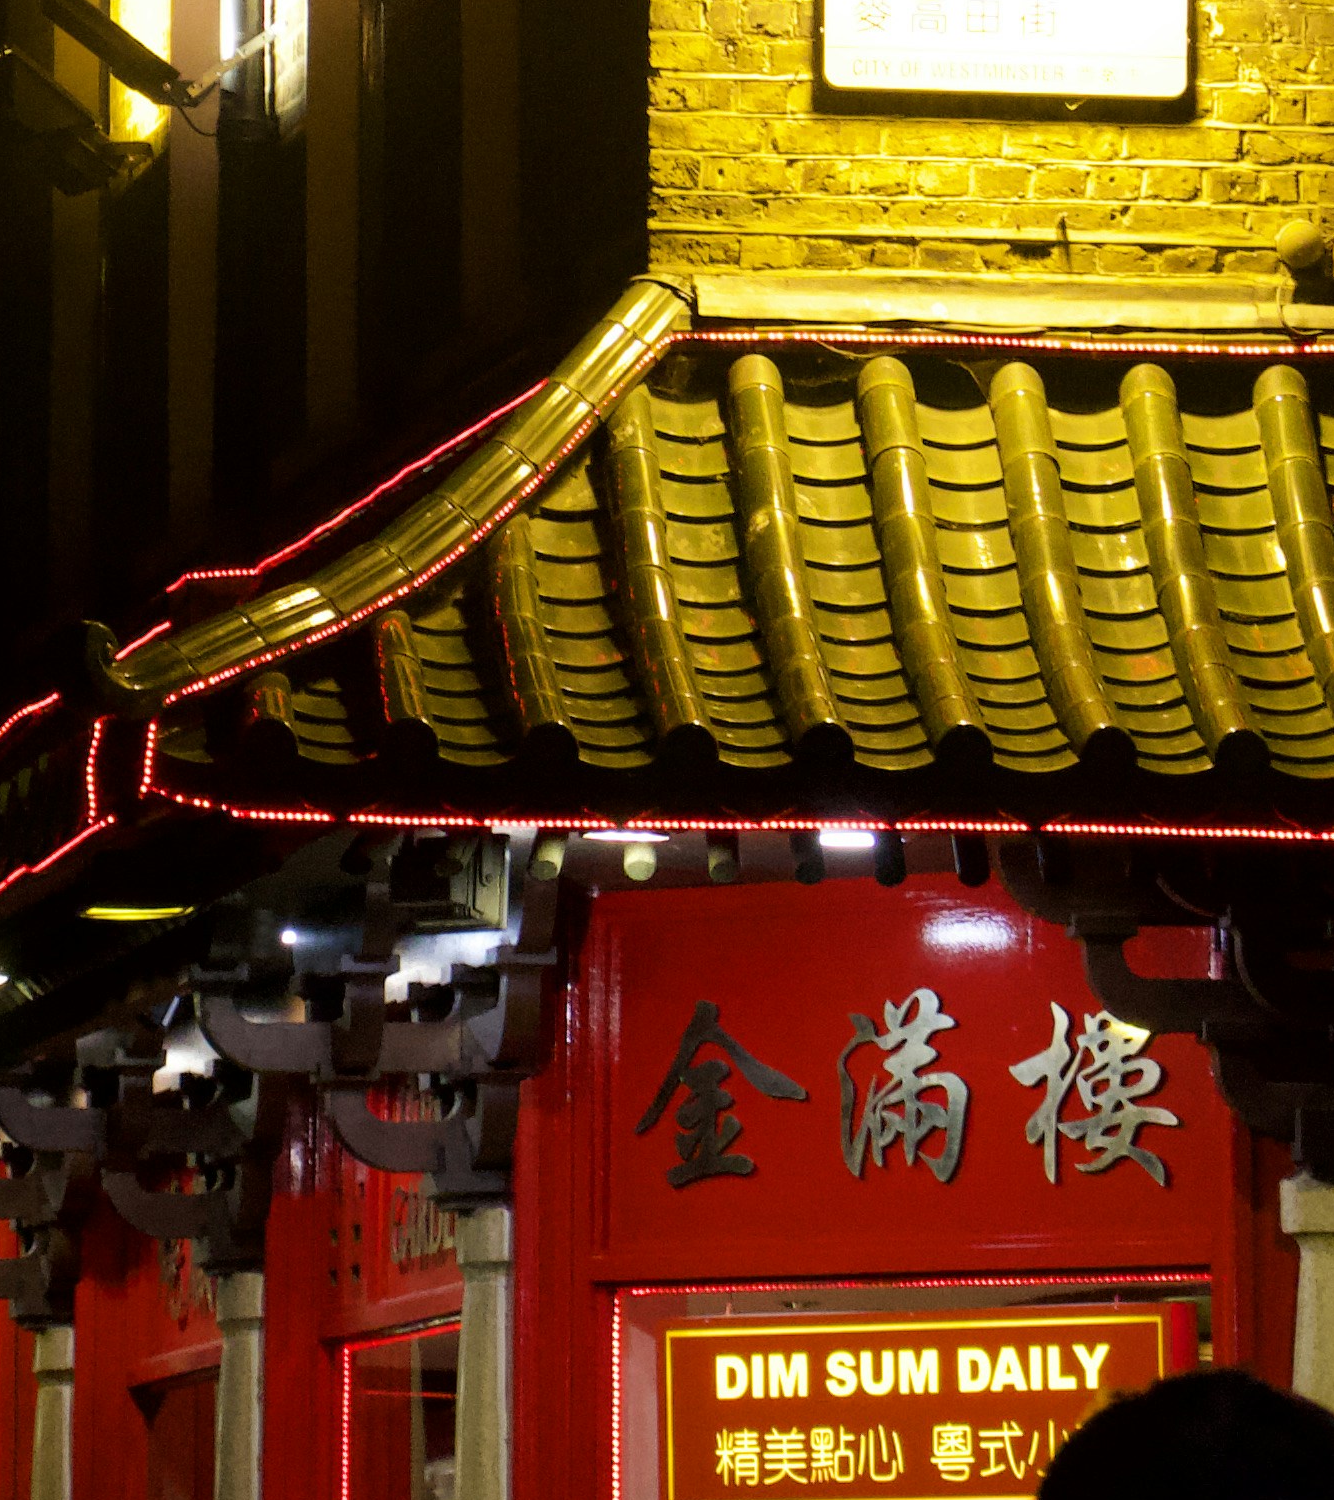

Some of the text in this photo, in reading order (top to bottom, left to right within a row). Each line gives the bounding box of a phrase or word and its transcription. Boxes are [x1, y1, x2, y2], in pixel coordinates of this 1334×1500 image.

[852, 58, 892, 79] CITY
[900, 59, 921, 80] OF
[931, 61, 1065, 82] WESTMINSTER
[635, 988, 1179, 1188] 金滿樓
[714, 1344, 1110, 1400] DIM SUM DAILY
[931, 1417, 1081, 1482] 粵式小
